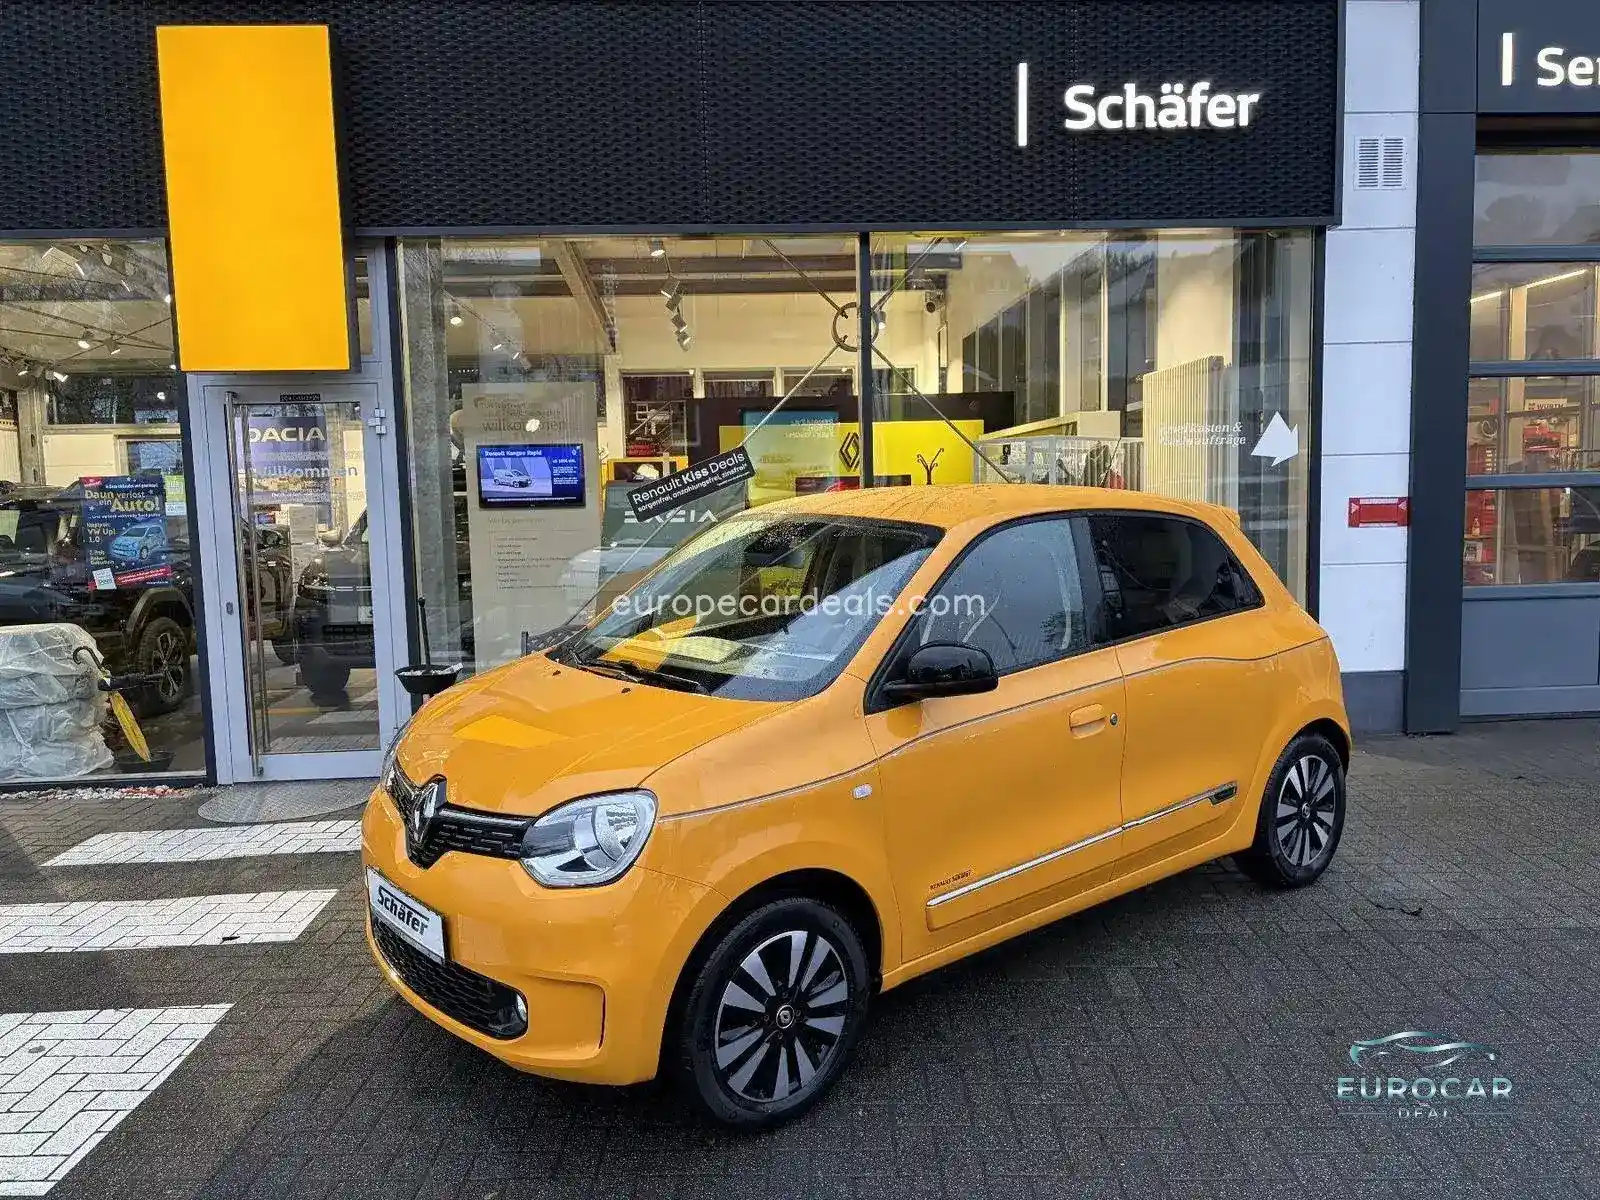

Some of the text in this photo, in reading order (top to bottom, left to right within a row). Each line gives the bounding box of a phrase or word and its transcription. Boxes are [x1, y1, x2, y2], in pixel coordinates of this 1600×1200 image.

[1064, 82, 1259, 130] Schäfer
[85, 490, 114, 499] Daun
[632, 478, 682, 504] Renault
[682, 468, 710, 485] Kiss
[708, 452, 746, 474] Deals
[637, 495, 673, 512] sorgenfrei,
[672, 474, 722, 498] anzahlungsfrei,
[111, 496, 159, 511] Auto!
[378, 885, 429, 935] Schäfer
